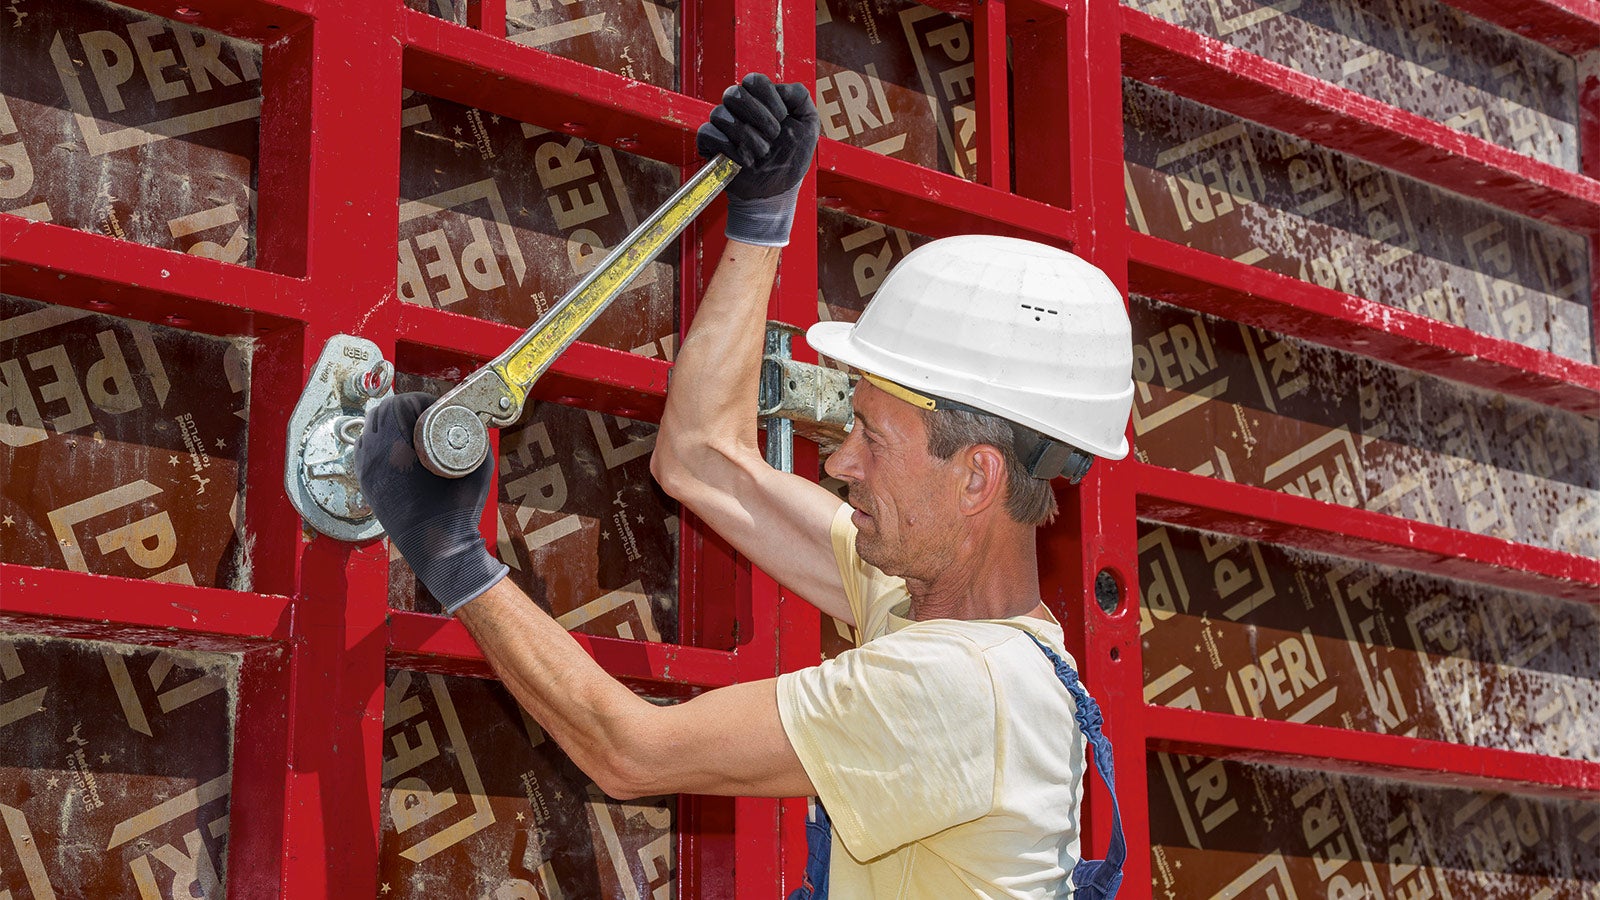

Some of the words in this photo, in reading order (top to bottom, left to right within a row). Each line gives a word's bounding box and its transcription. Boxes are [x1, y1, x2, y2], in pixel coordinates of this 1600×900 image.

[79, 20, 260, 113] PERI
[464, 109, 489, 161] formPLUS
[1132, 316, 1218, 404] PERI
[184, 411, 211, 468] formPLUS
[610, 513, 636, 562] formPLUS
[1238, 626, 1327, 718] PERI
[526, 769, 551, 820] formPLUS
